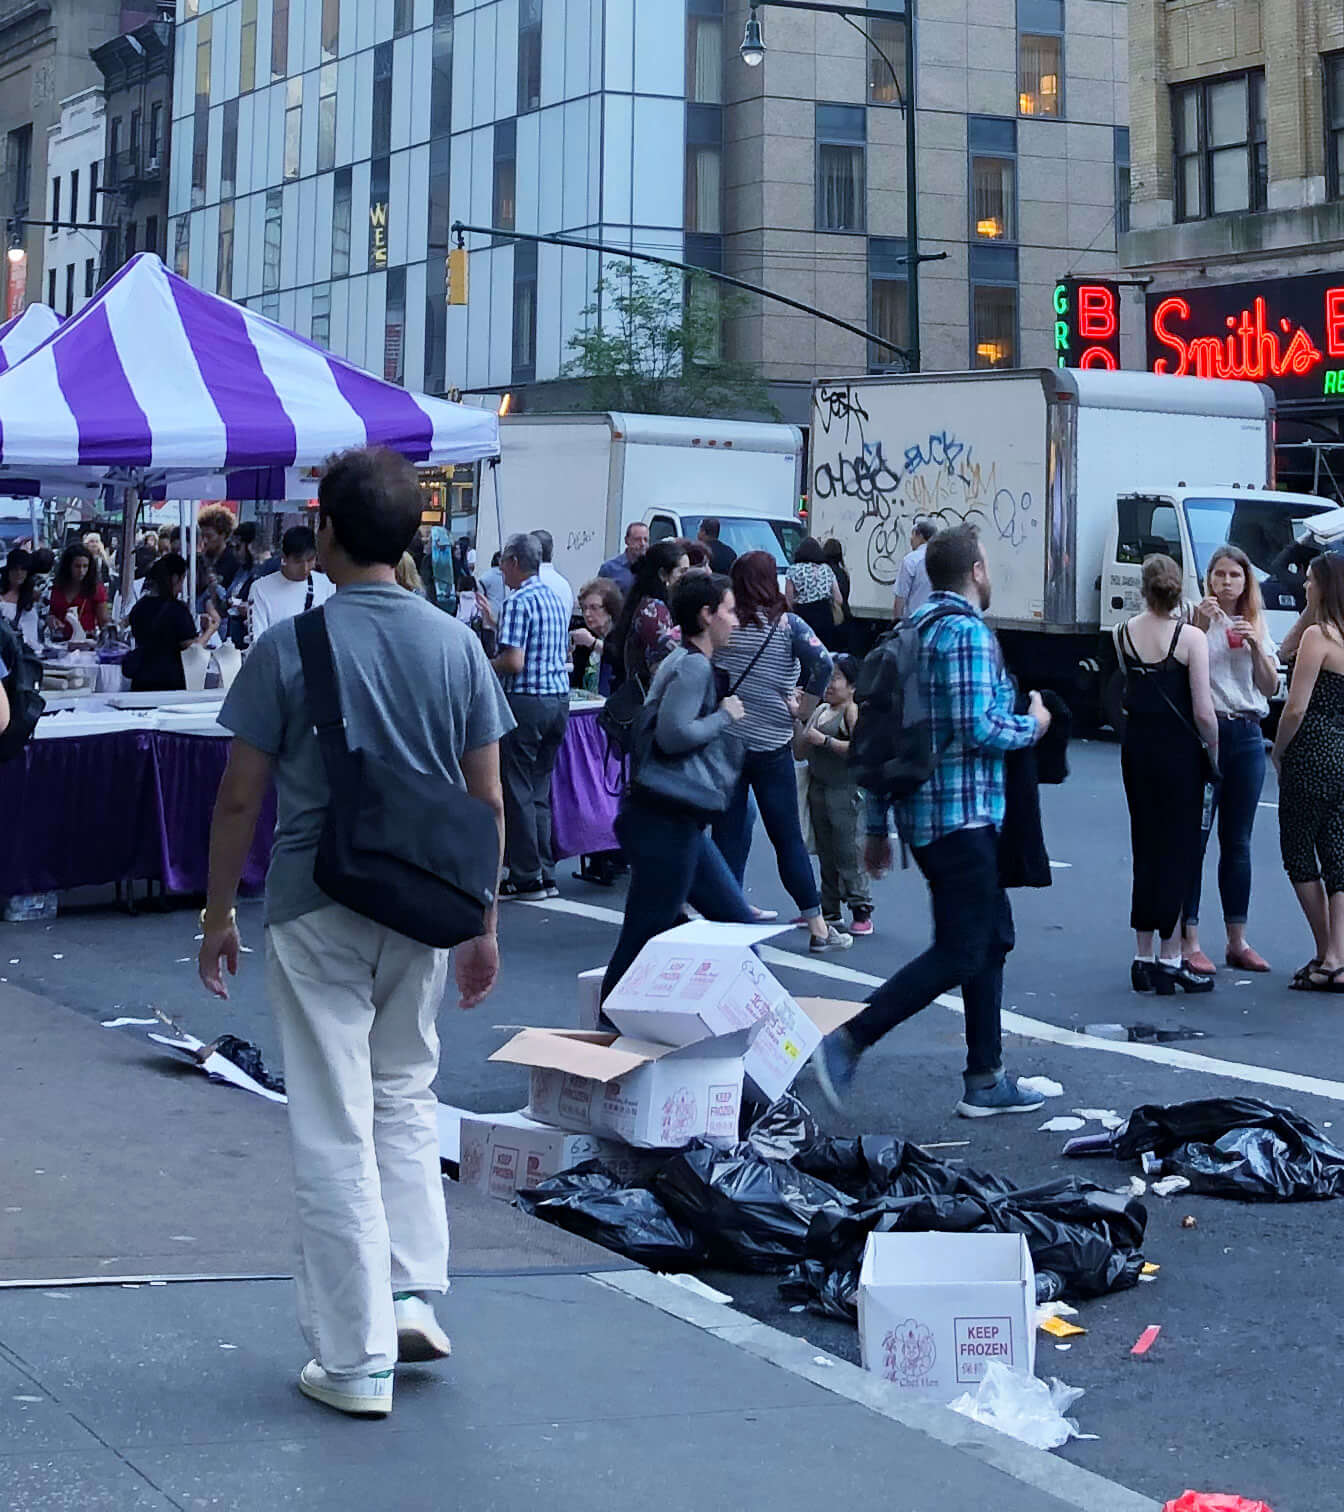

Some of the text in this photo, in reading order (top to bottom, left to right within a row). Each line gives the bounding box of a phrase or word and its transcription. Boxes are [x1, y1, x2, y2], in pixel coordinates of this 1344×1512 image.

[1153, 296, 1323, 379] Smith's
[967, 1326, 999, 1339] KEEP
[960, 1343, 1008, 1356] FROZEN
